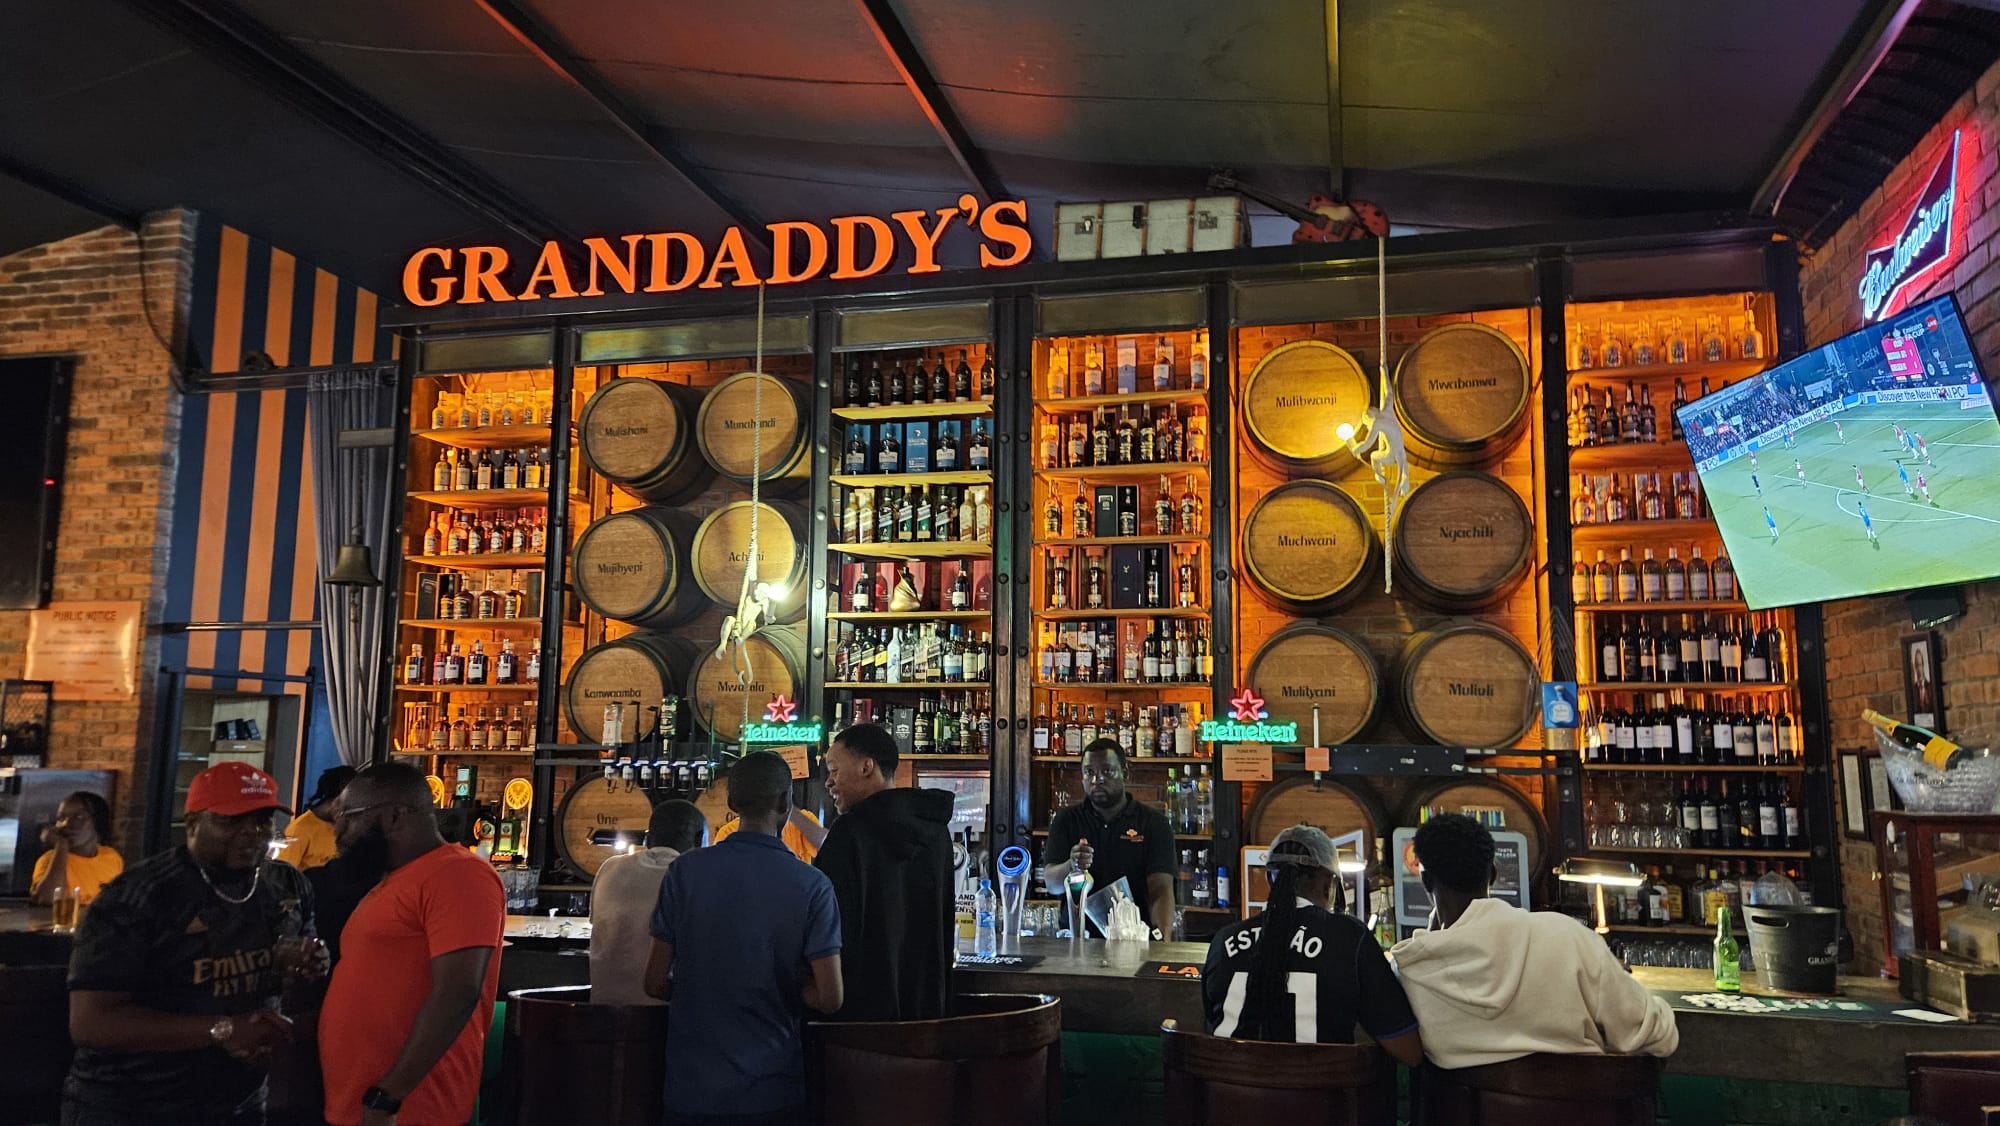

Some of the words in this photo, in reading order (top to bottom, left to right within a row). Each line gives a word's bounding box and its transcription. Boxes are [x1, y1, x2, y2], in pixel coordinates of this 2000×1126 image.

[402, 193, 1032, 307] GRANDADDY'S
[1877, 390, 1903, 401] Discover
[1904, 390, 1914, 400] the
[1915, 389, 1932, 400] New
[1953, 386, 1966, 398] PC
[1831, 400, 1843, 411] PC
[53, 611, 83, 621] PUBLIC
[86, 610, 117, 621] NOTICE
[717, 680, 765, 693] Mwaola
[739, 723, 821, 741] Heineken
[1201, 720, 1297, 742] Heineken
[596, 812, 618, 825] One
[1224, 924, 1323, 959] ESTÃO
